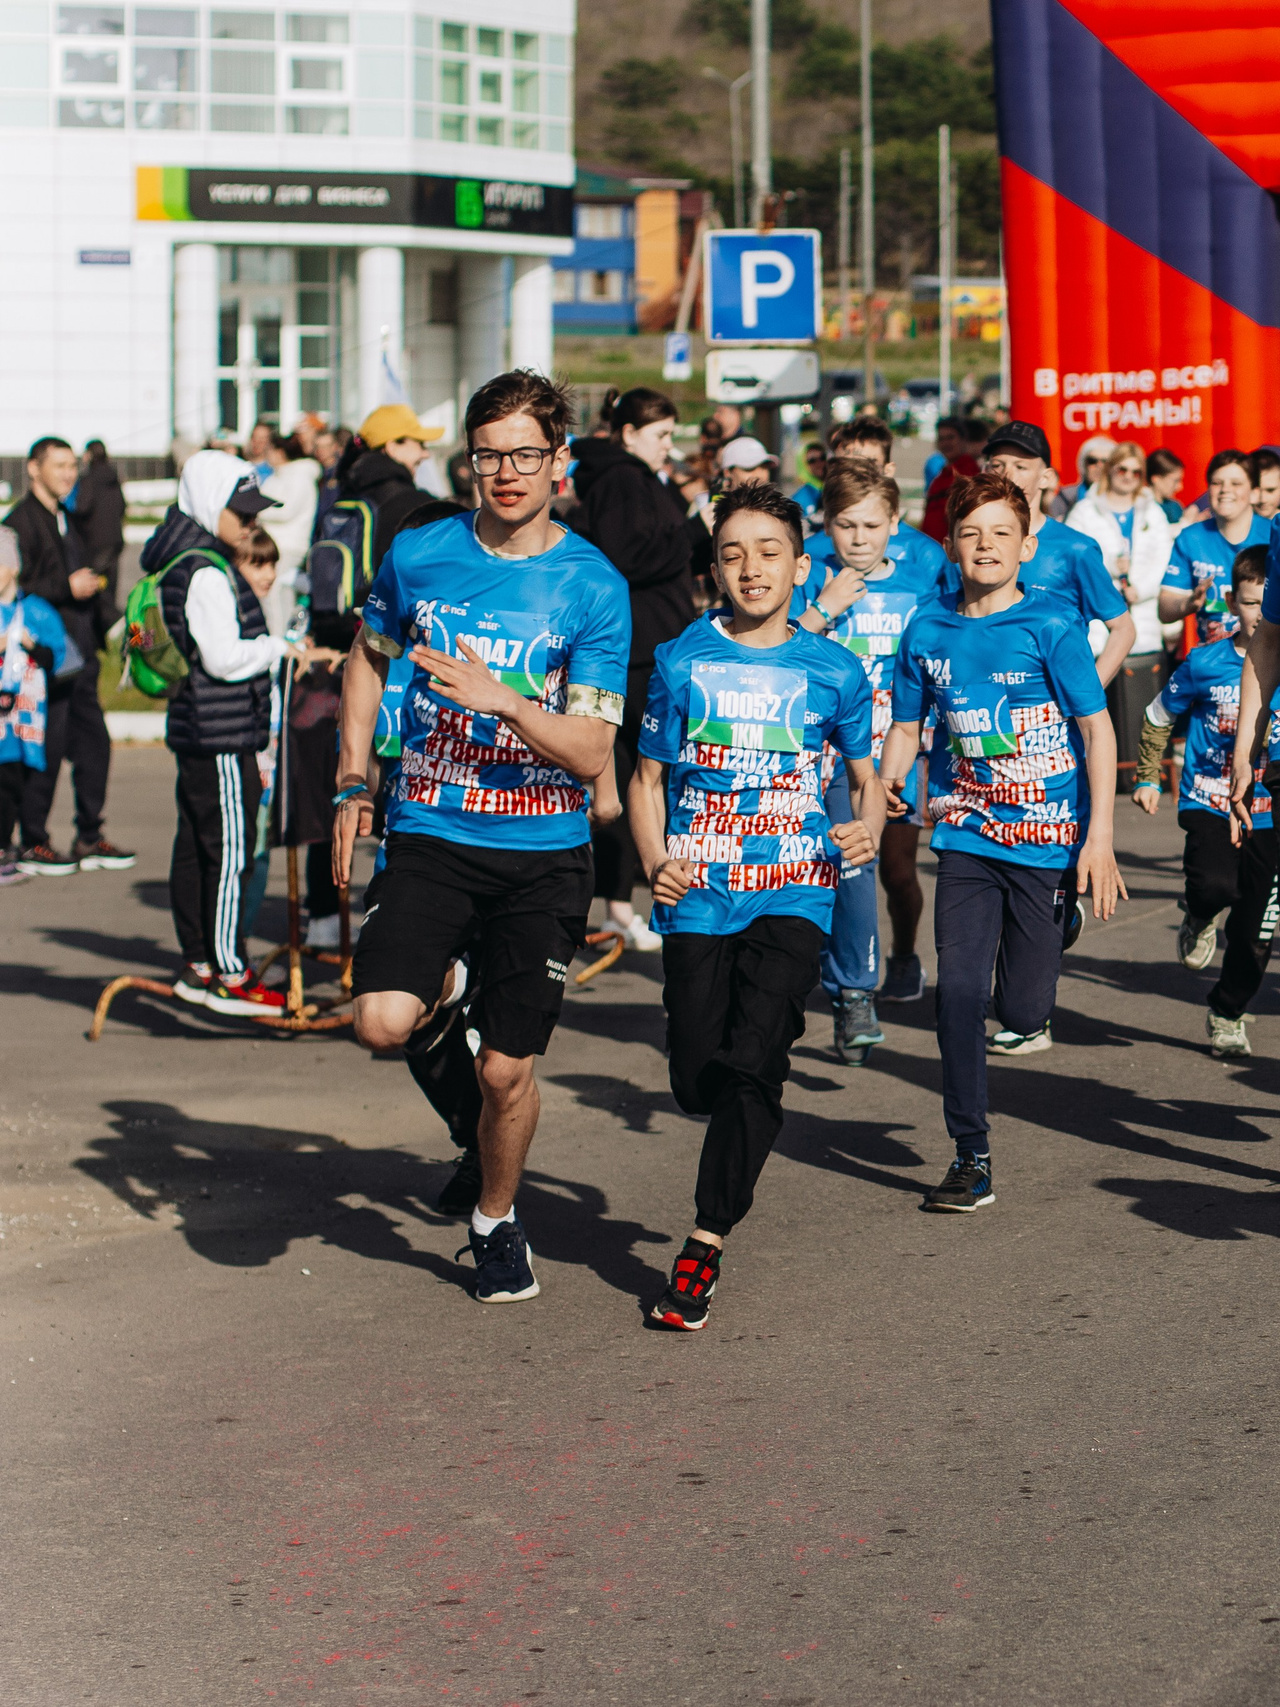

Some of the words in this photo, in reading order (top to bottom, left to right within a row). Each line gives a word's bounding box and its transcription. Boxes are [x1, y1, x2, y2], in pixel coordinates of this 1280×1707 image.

[1034, 368, 1059, 397] В
[1062, 369, 1157, 400] ритме
[1161, 358, 1230, 391] всей
[1063, 395, 1202, 432] СТРАНЫ!
[855, 612, 902, 634] 10026
[716, 690, 782, 722] 10052
[778, 834, 827, 863] 2024
